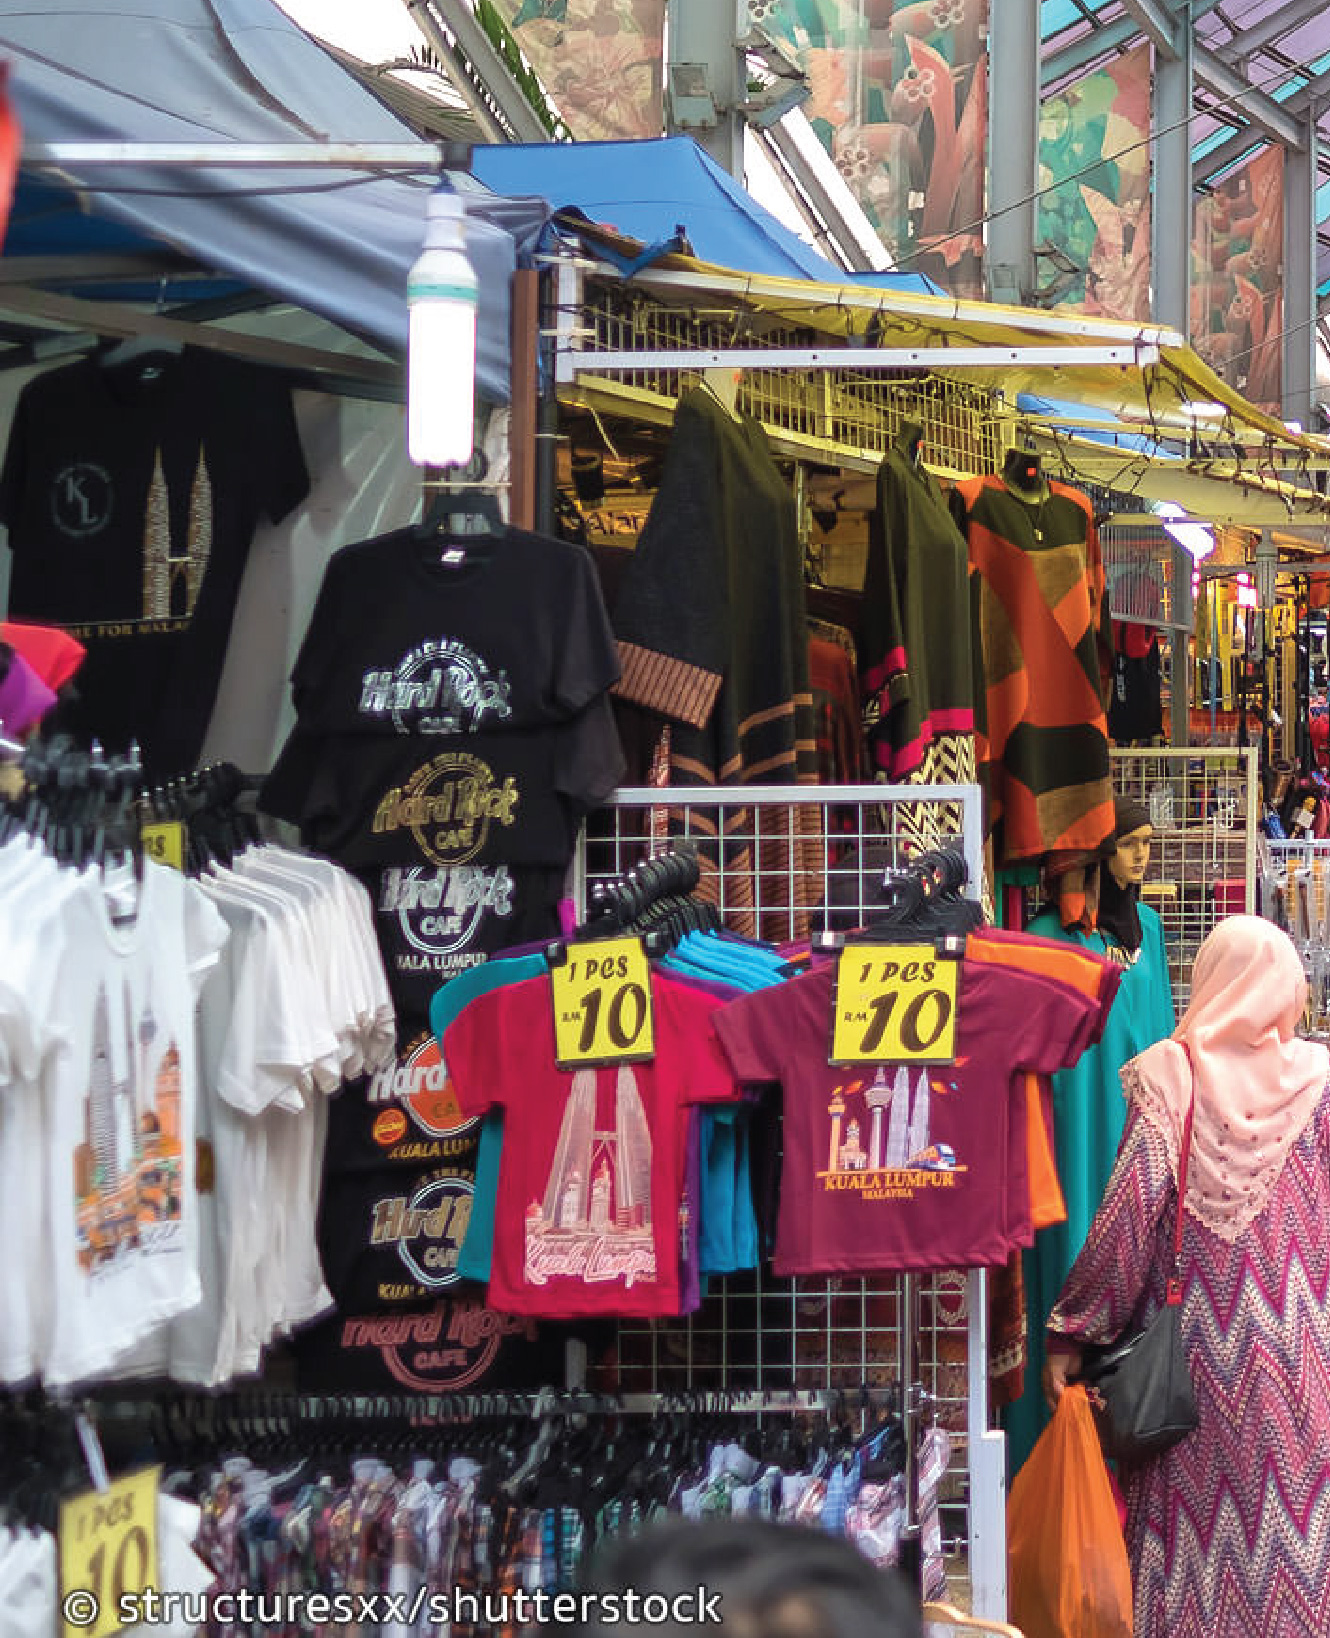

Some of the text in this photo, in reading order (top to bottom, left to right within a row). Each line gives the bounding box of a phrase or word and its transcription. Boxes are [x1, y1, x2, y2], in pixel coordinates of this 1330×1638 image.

[359, 666, 513, 719] Hard Rock
[371, 776, 521, 833] Hard Rock
[420, 915, 463, 936] CAFE
[569, 955, 629, 983] 1 PCS
[859, 961, 937, 983] 1 PCS
[578, 981, 648, 1053] 10
[859, 988, 952, 1054] 10
[824, 1170, 956, 1192] KUALA LUMPUR
[412, 1348, 469, 1370] CAFE
[91, 1491, 136, 1535] PCS
[83, 1524, 150, 1636] 10
